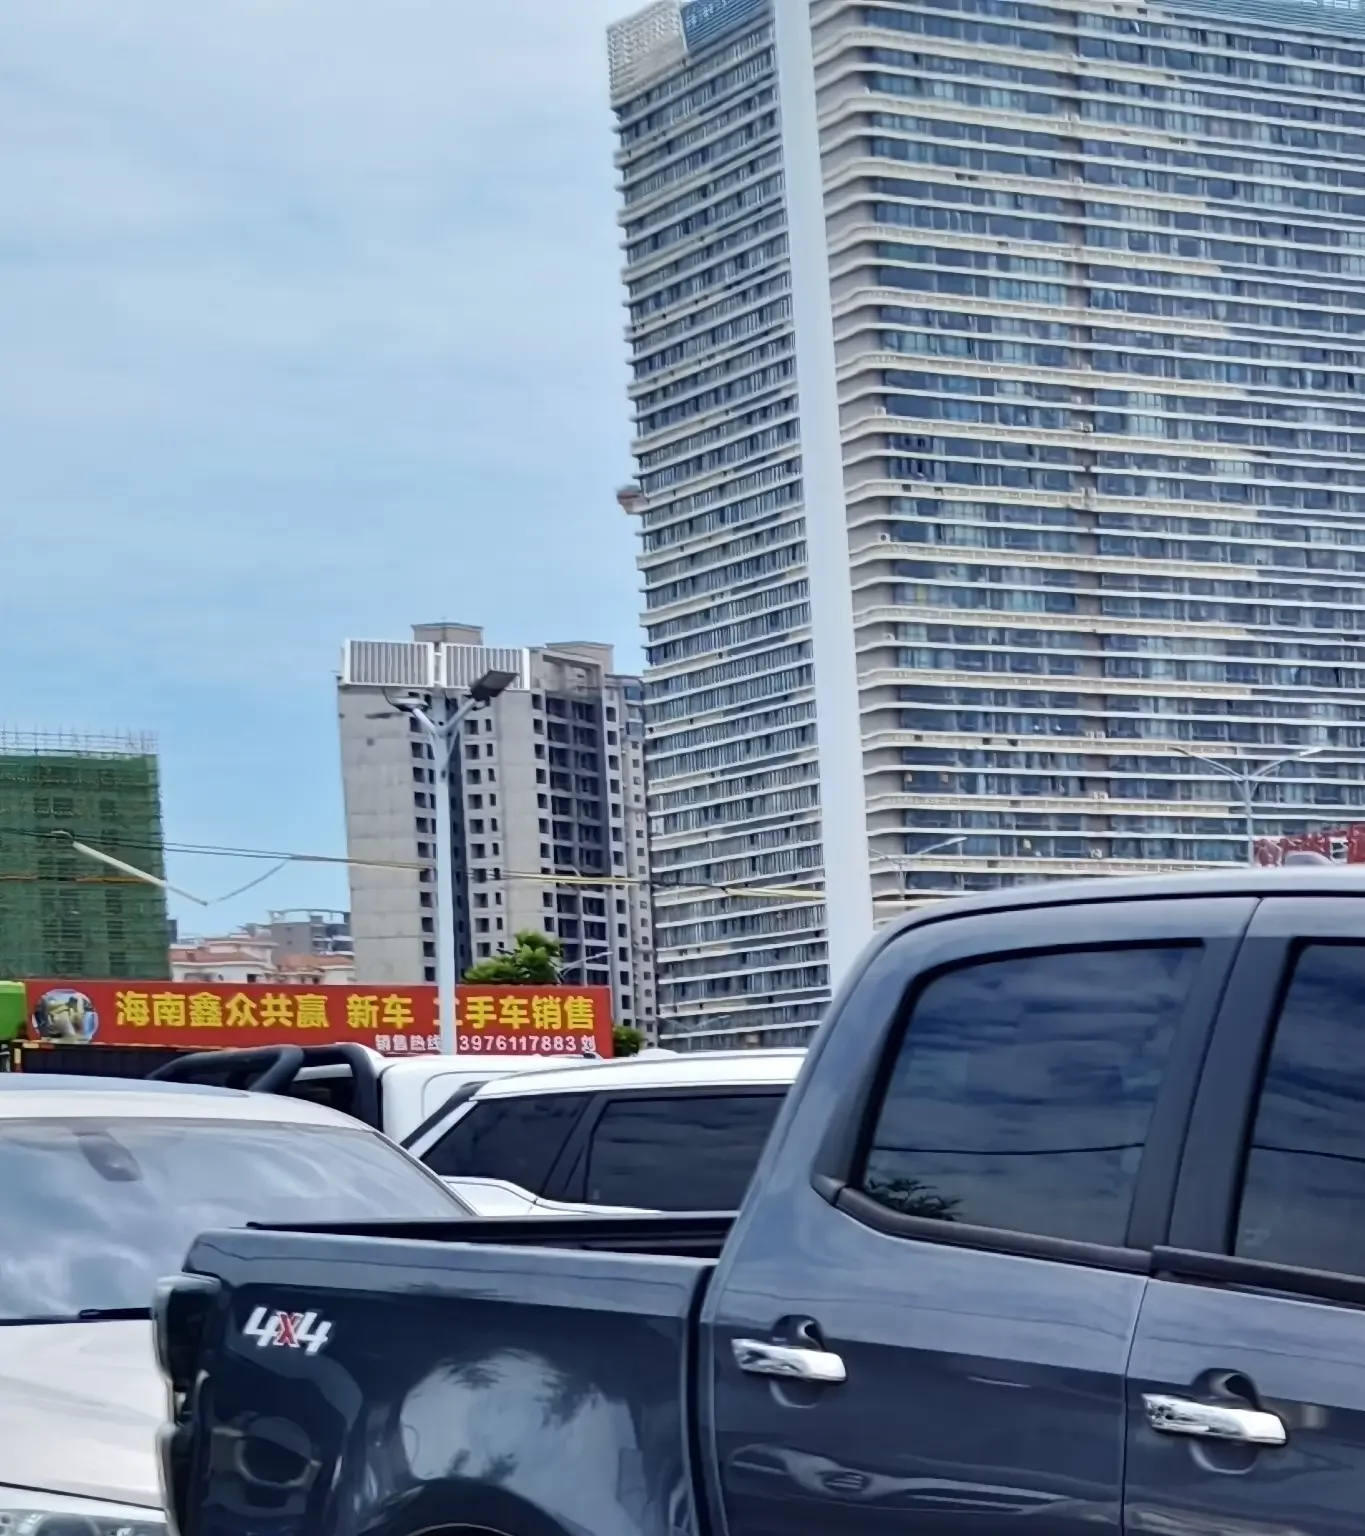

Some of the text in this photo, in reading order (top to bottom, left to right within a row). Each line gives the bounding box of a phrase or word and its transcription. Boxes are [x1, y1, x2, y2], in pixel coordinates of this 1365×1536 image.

[115, 990, 330, 1028] 海南鑫众共赢
[345, 993, 415, 1029] 新车
